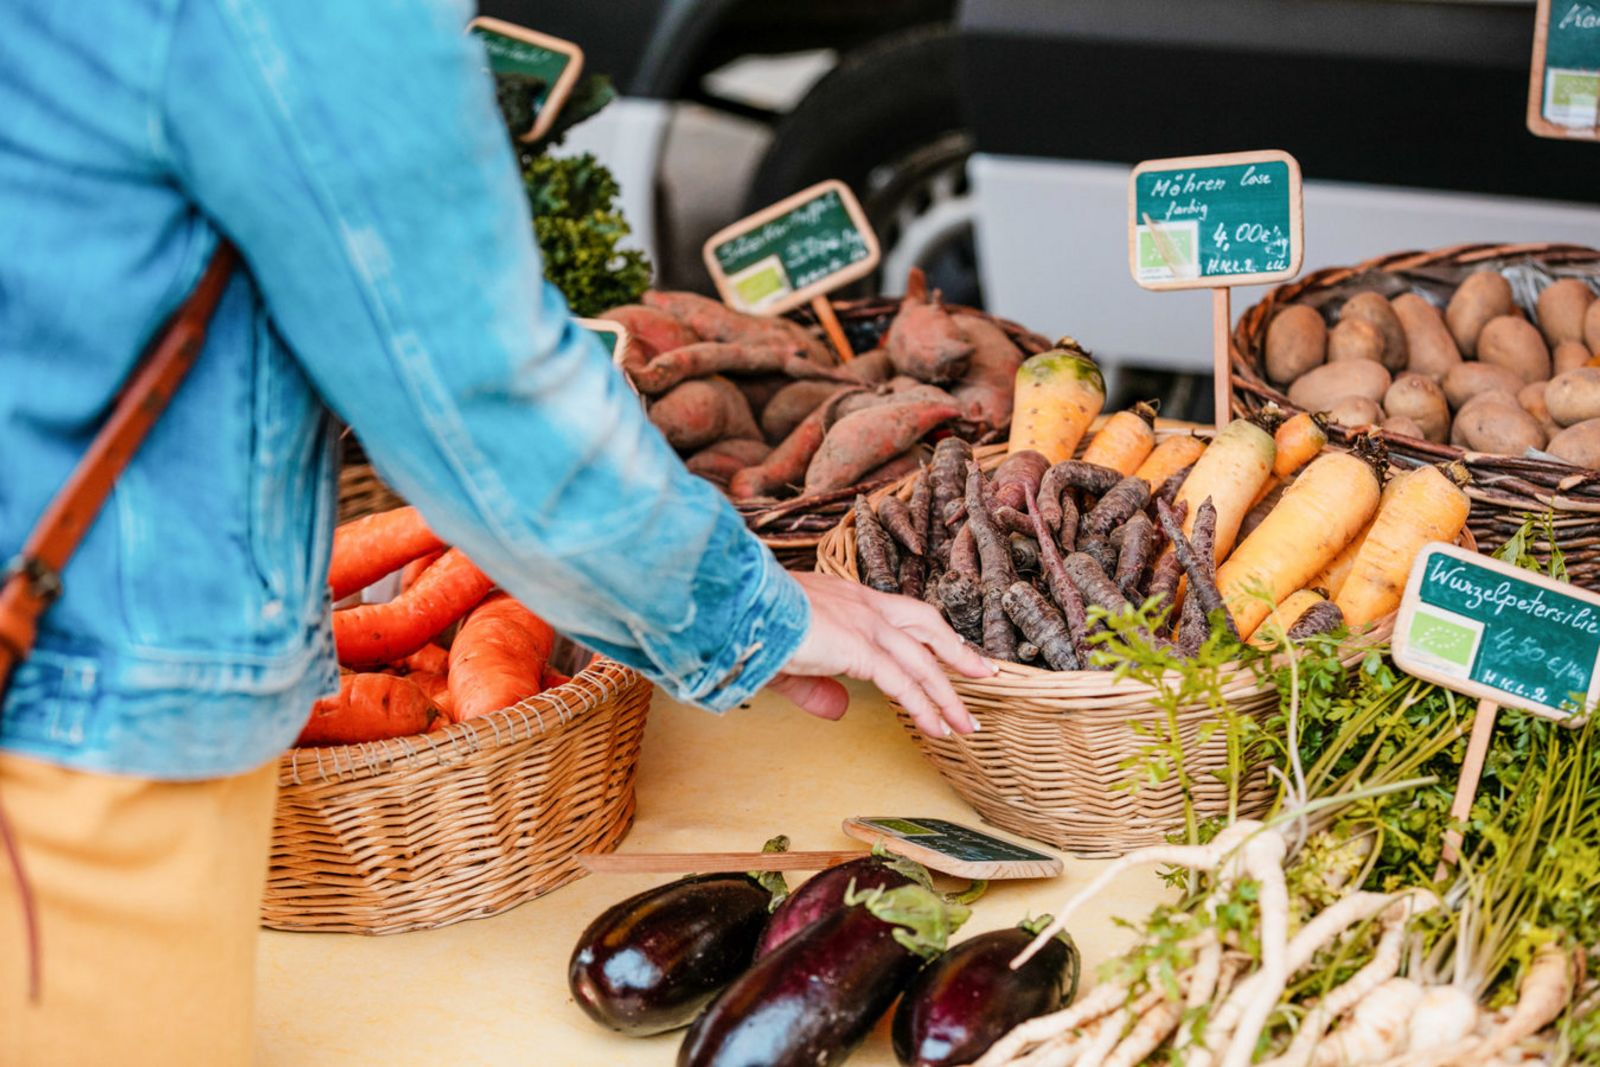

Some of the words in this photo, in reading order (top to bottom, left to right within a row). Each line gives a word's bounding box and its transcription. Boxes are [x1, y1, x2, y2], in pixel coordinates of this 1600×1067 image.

[1150, 173, 1226, 198] Möhren
[1240, 165, 1272, 187] lose
[1164, 198, 1209, 222] farbig
[1429, 559, 1599, 634] Wurzelpetersilie
